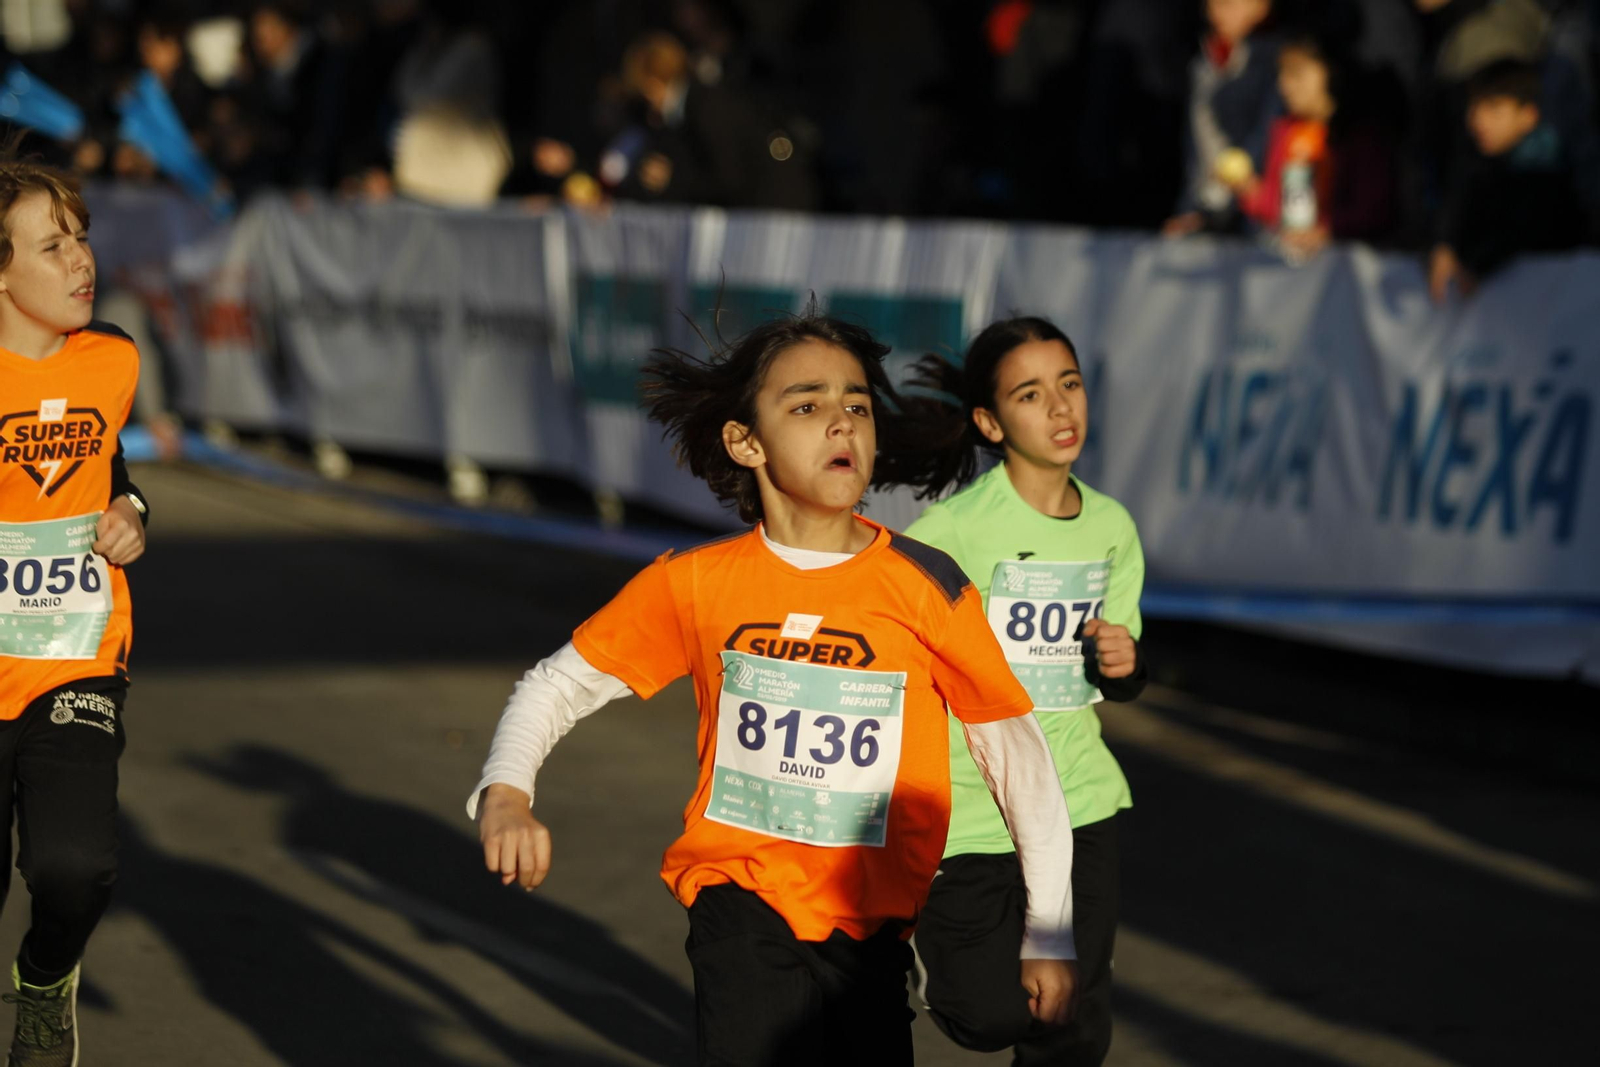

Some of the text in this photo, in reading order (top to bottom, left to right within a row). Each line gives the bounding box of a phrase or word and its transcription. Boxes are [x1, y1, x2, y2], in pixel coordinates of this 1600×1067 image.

[14, 421, 94, 443] SUPER
[2, 438, 103, 463] RUNNER
[1374, 380, 1592, 546] NEXA
[0, 552, 101, 596] 056
[19, 597, 62, 608] MARIO
[748, 637, 854, 667] SUPER
[760, 667, 787, 680] MEDIO
[758, 676, 801, 691] MARATÓN
[839, 681, 893, 695] CARRERA
[757, 685, 795, 699] ALMERÍA
[839, 695, 891, 708] INFANTIL
[737, 700, 881, 768] 8136
[779, 761, 826, 779] DAVID
[724, 774, 745, 788] NEXA
[771, 774, 788, 784] DAVID
[788, 777, 811, 788] ORTEGA
